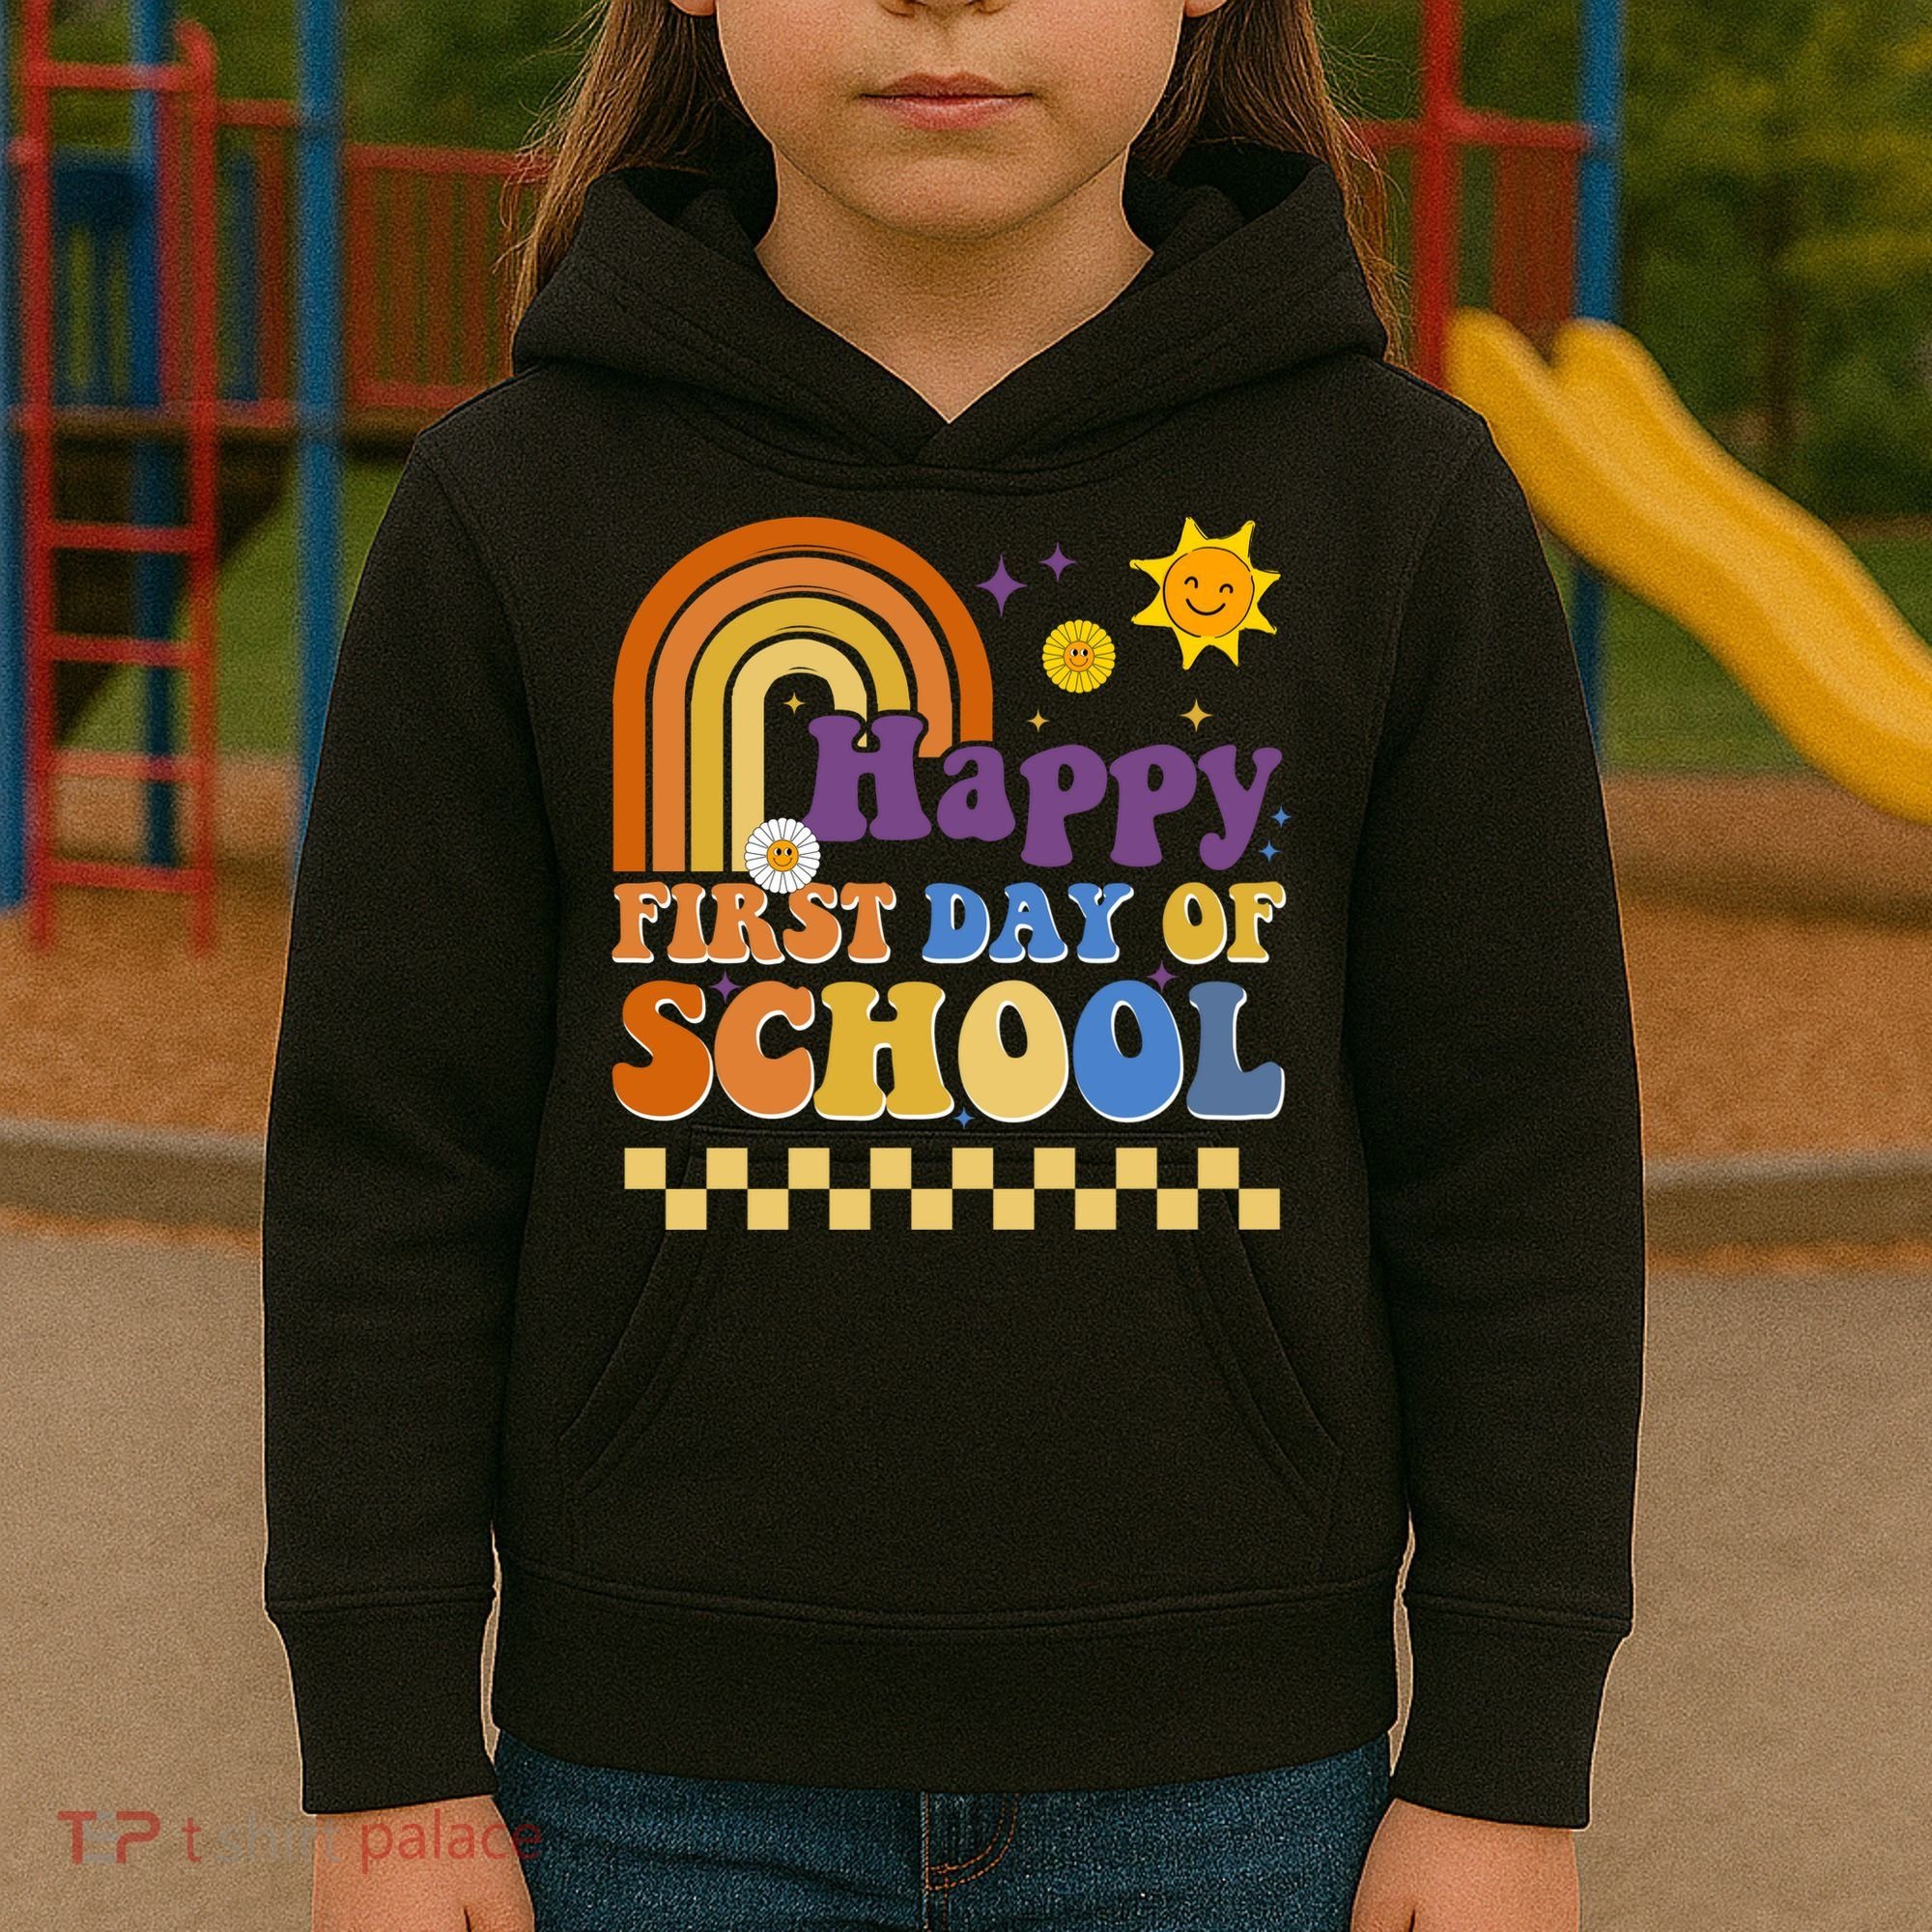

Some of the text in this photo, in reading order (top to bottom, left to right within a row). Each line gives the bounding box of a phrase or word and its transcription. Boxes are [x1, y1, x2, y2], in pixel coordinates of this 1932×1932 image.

[800, 714, 1283, 870] Happy
[611, 880, 1287, 965] FIRST DAY OF
[611, 979, 1286, 1123] SCHOOL
